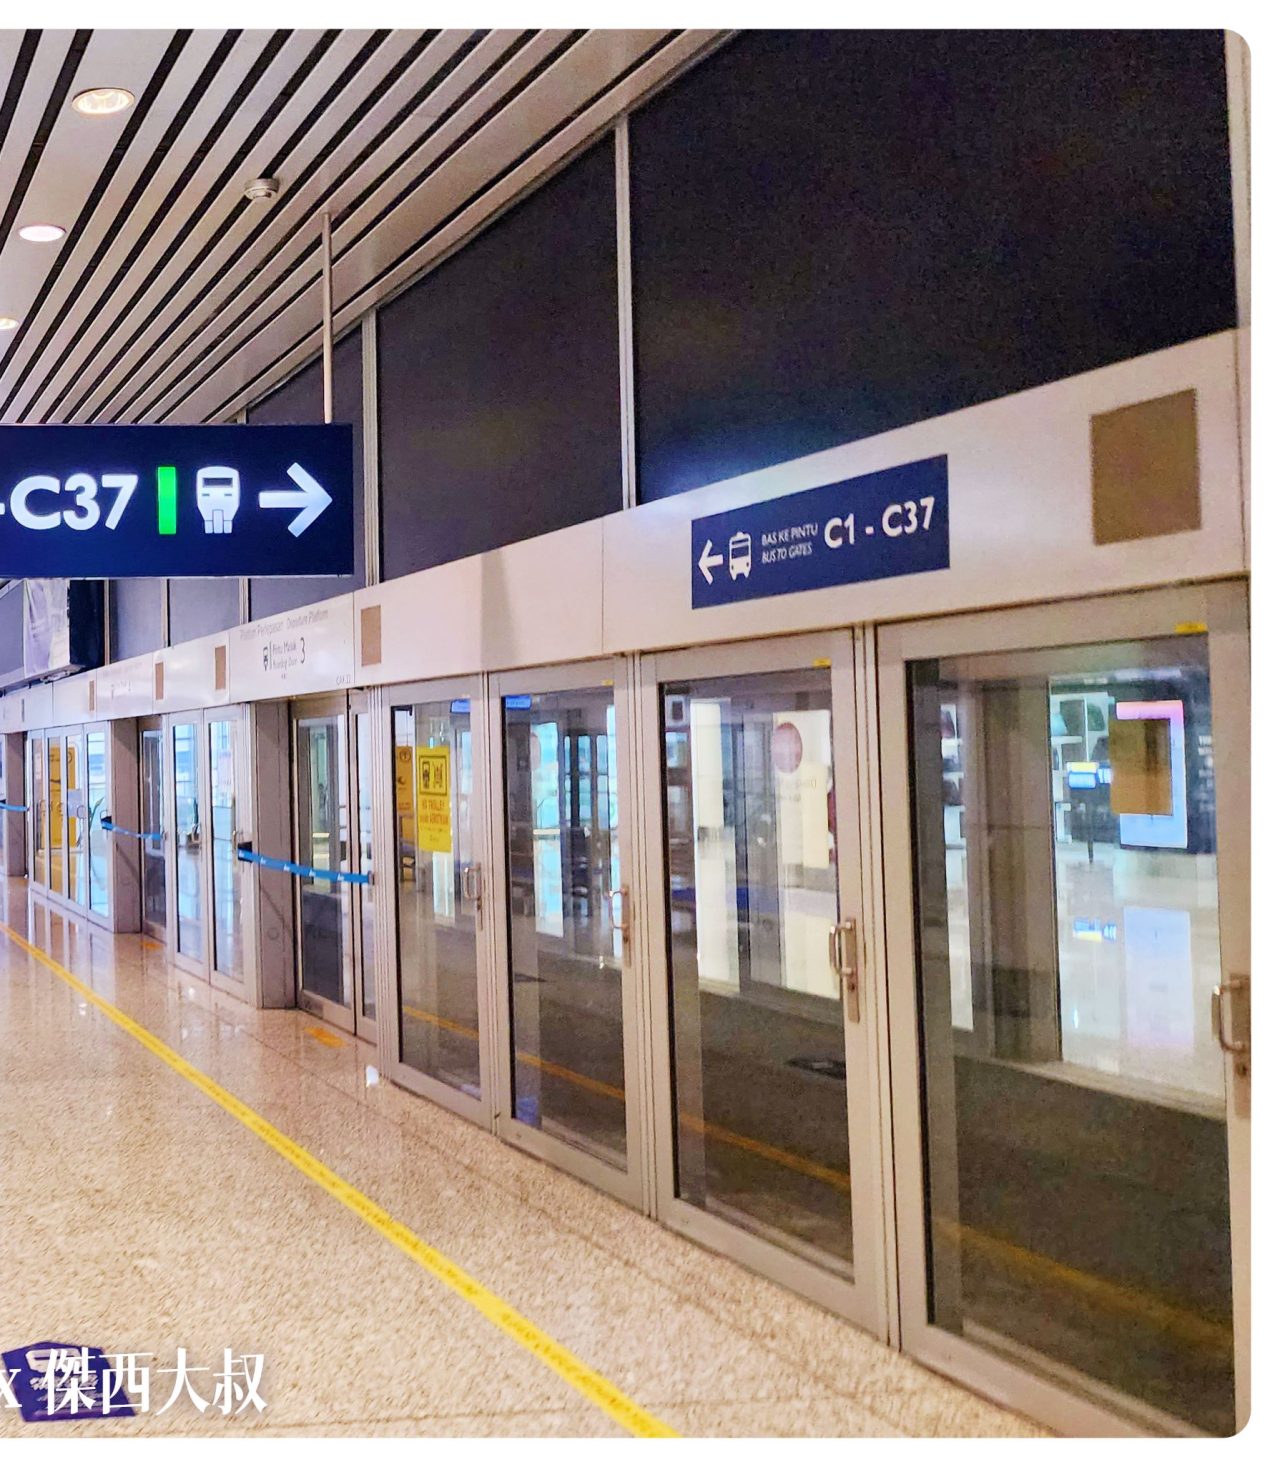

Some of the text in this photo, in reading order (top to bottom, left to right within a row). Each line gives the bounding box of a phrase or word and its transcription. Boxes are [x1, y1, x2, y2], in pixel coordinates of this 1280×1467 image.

[761, 522, 819, 546] BAS KE PINTU
[823, 513, 856, 549] C1
[881, 495, 936, 538] C37
[761, 540, 813, 565] BUS TO GATES
